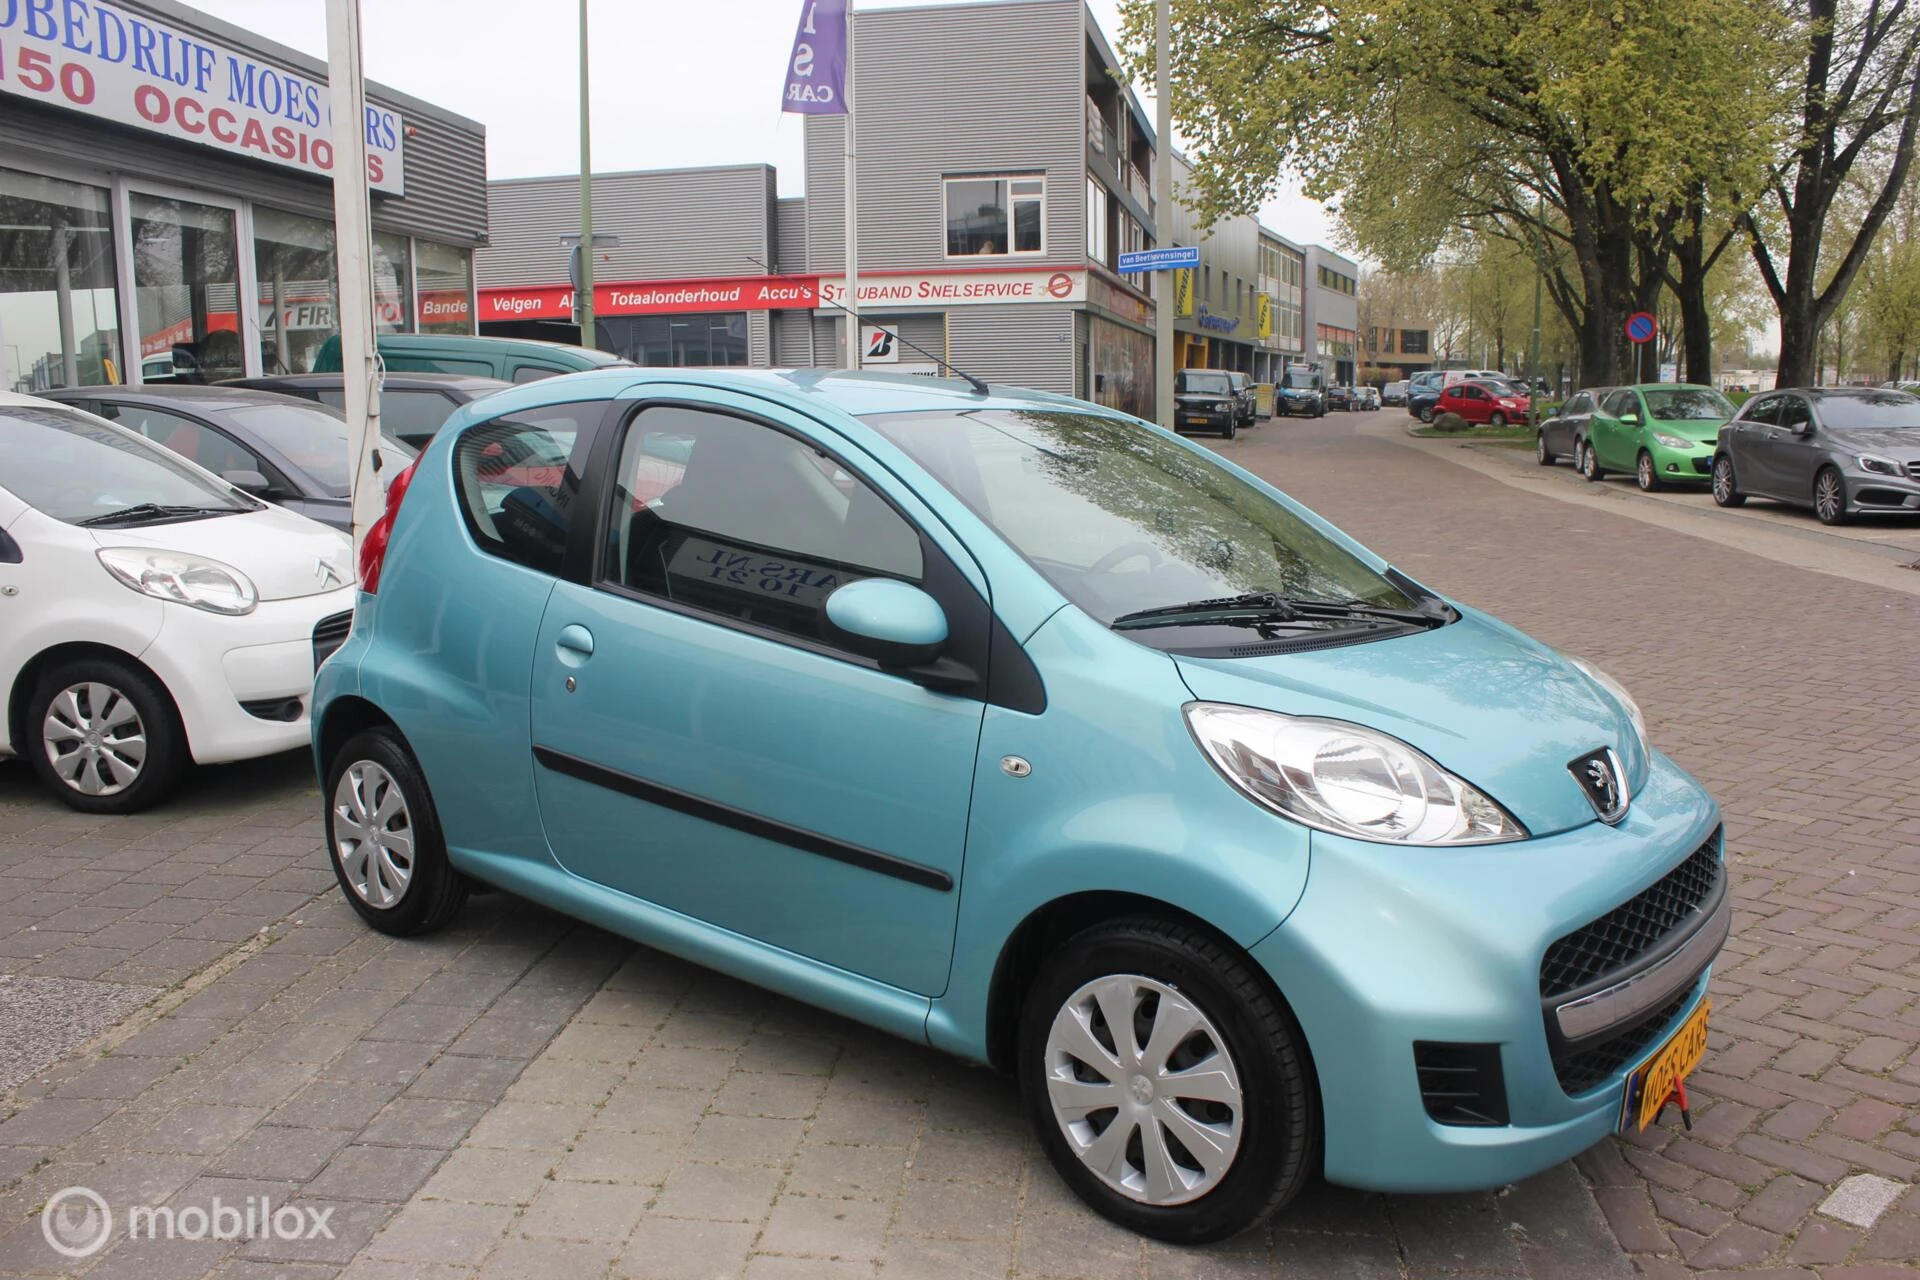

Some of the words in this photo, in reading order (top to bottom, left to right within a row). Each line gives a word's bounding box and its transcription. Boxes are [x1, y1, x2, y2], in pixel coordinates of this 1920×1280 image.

[0, 38, 96, 106] 50
[134, 84, 384, 184] OCCASIOS
[227, 56, 320, 128] MOES
[422, 300, 468, 315] Bande
[493, 296, 542, 314] Velgen
[610, 286, 741, 307] Totaalonderhoud
[757, 285, 813, 301] Accu's
[823, 284, 912, 301] STUBAND
[1643, 1045, 1679, 1116] MOES
